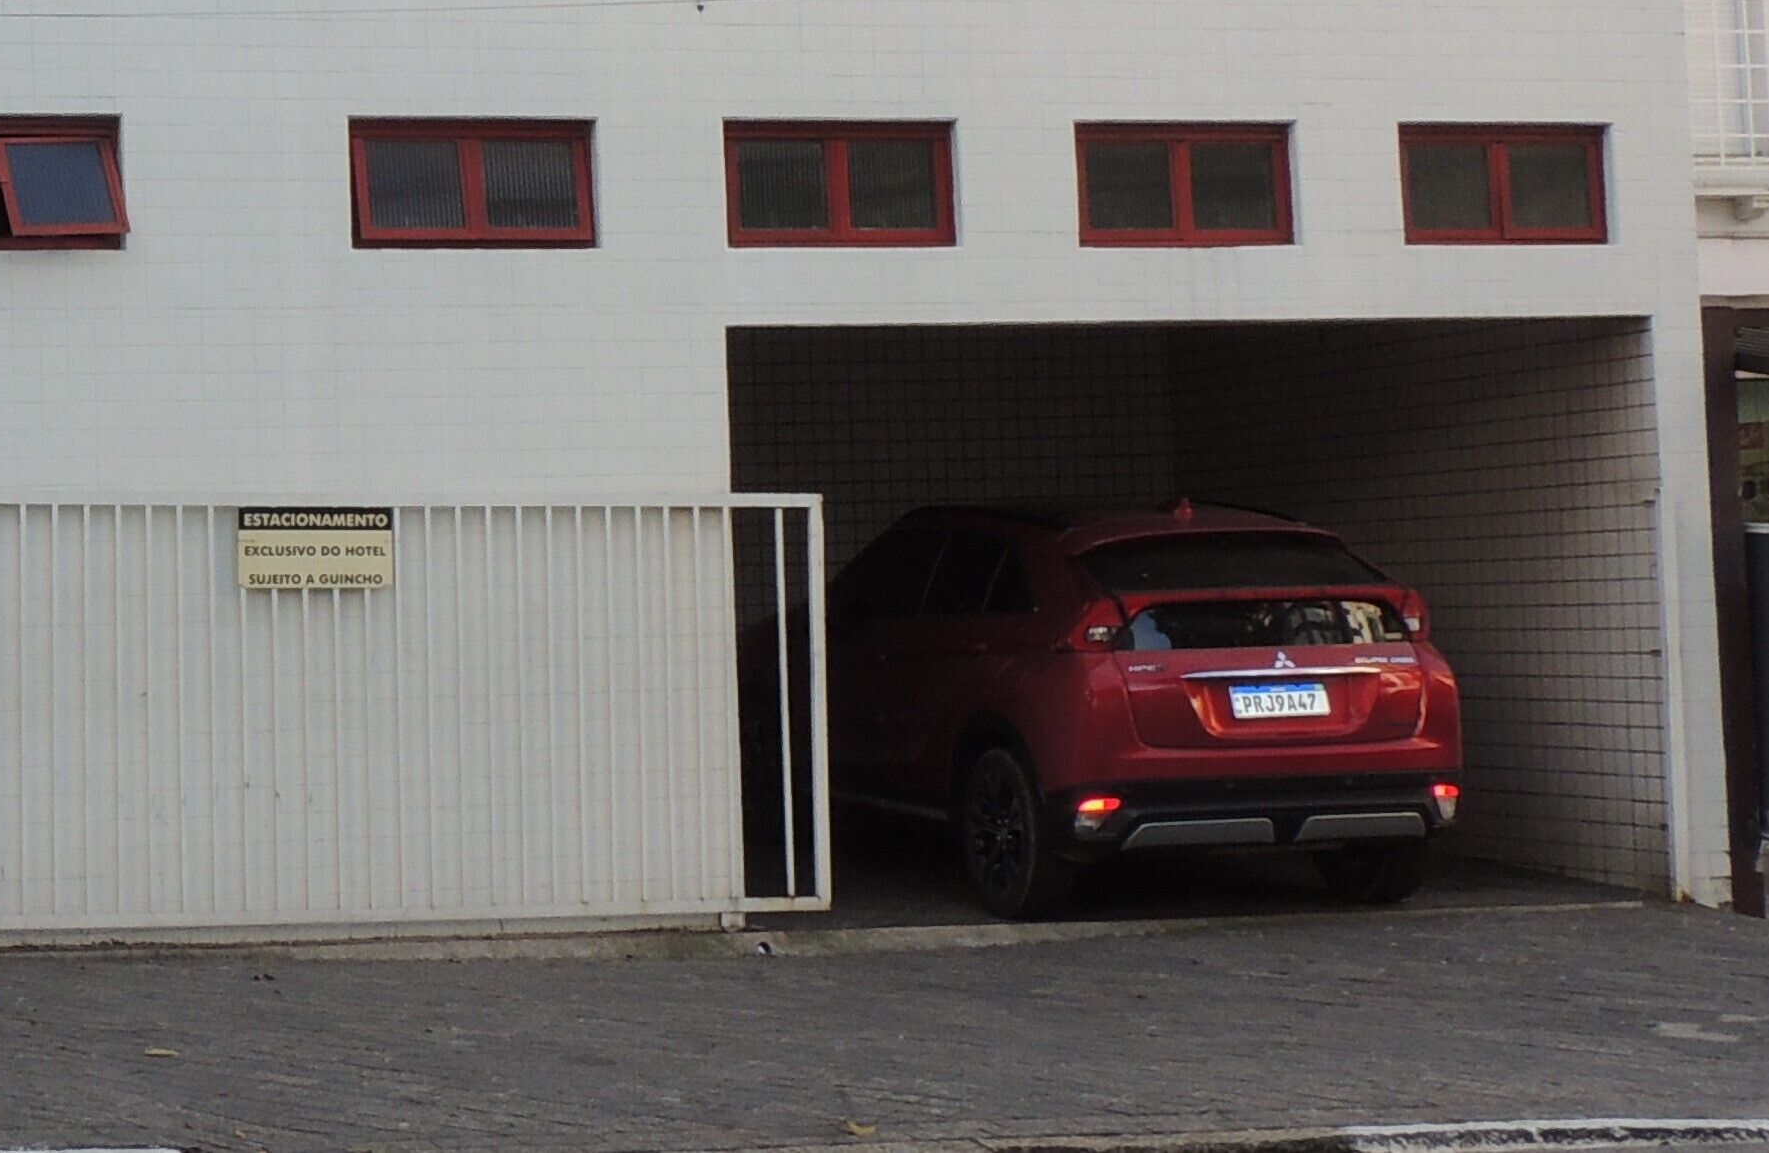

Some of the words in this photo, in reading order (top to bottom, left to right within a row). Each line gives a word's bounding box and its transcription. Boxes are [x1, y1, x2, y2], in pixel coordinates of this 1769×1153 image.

[243, 513, 389, 528] ESTACIONAMENTO
[244, 545, 317, 557] EXCLUSIVO
[320, 545, 341, 557] DO
[345, 545, 387, 557] HOTEL
[248, 573, 302, 585] SUJEITO
[305, 573, 315, 585] A
[318, 573, 384, 585] GUINCHO
[1241, 692, 1317, 714] PRJ9A47
